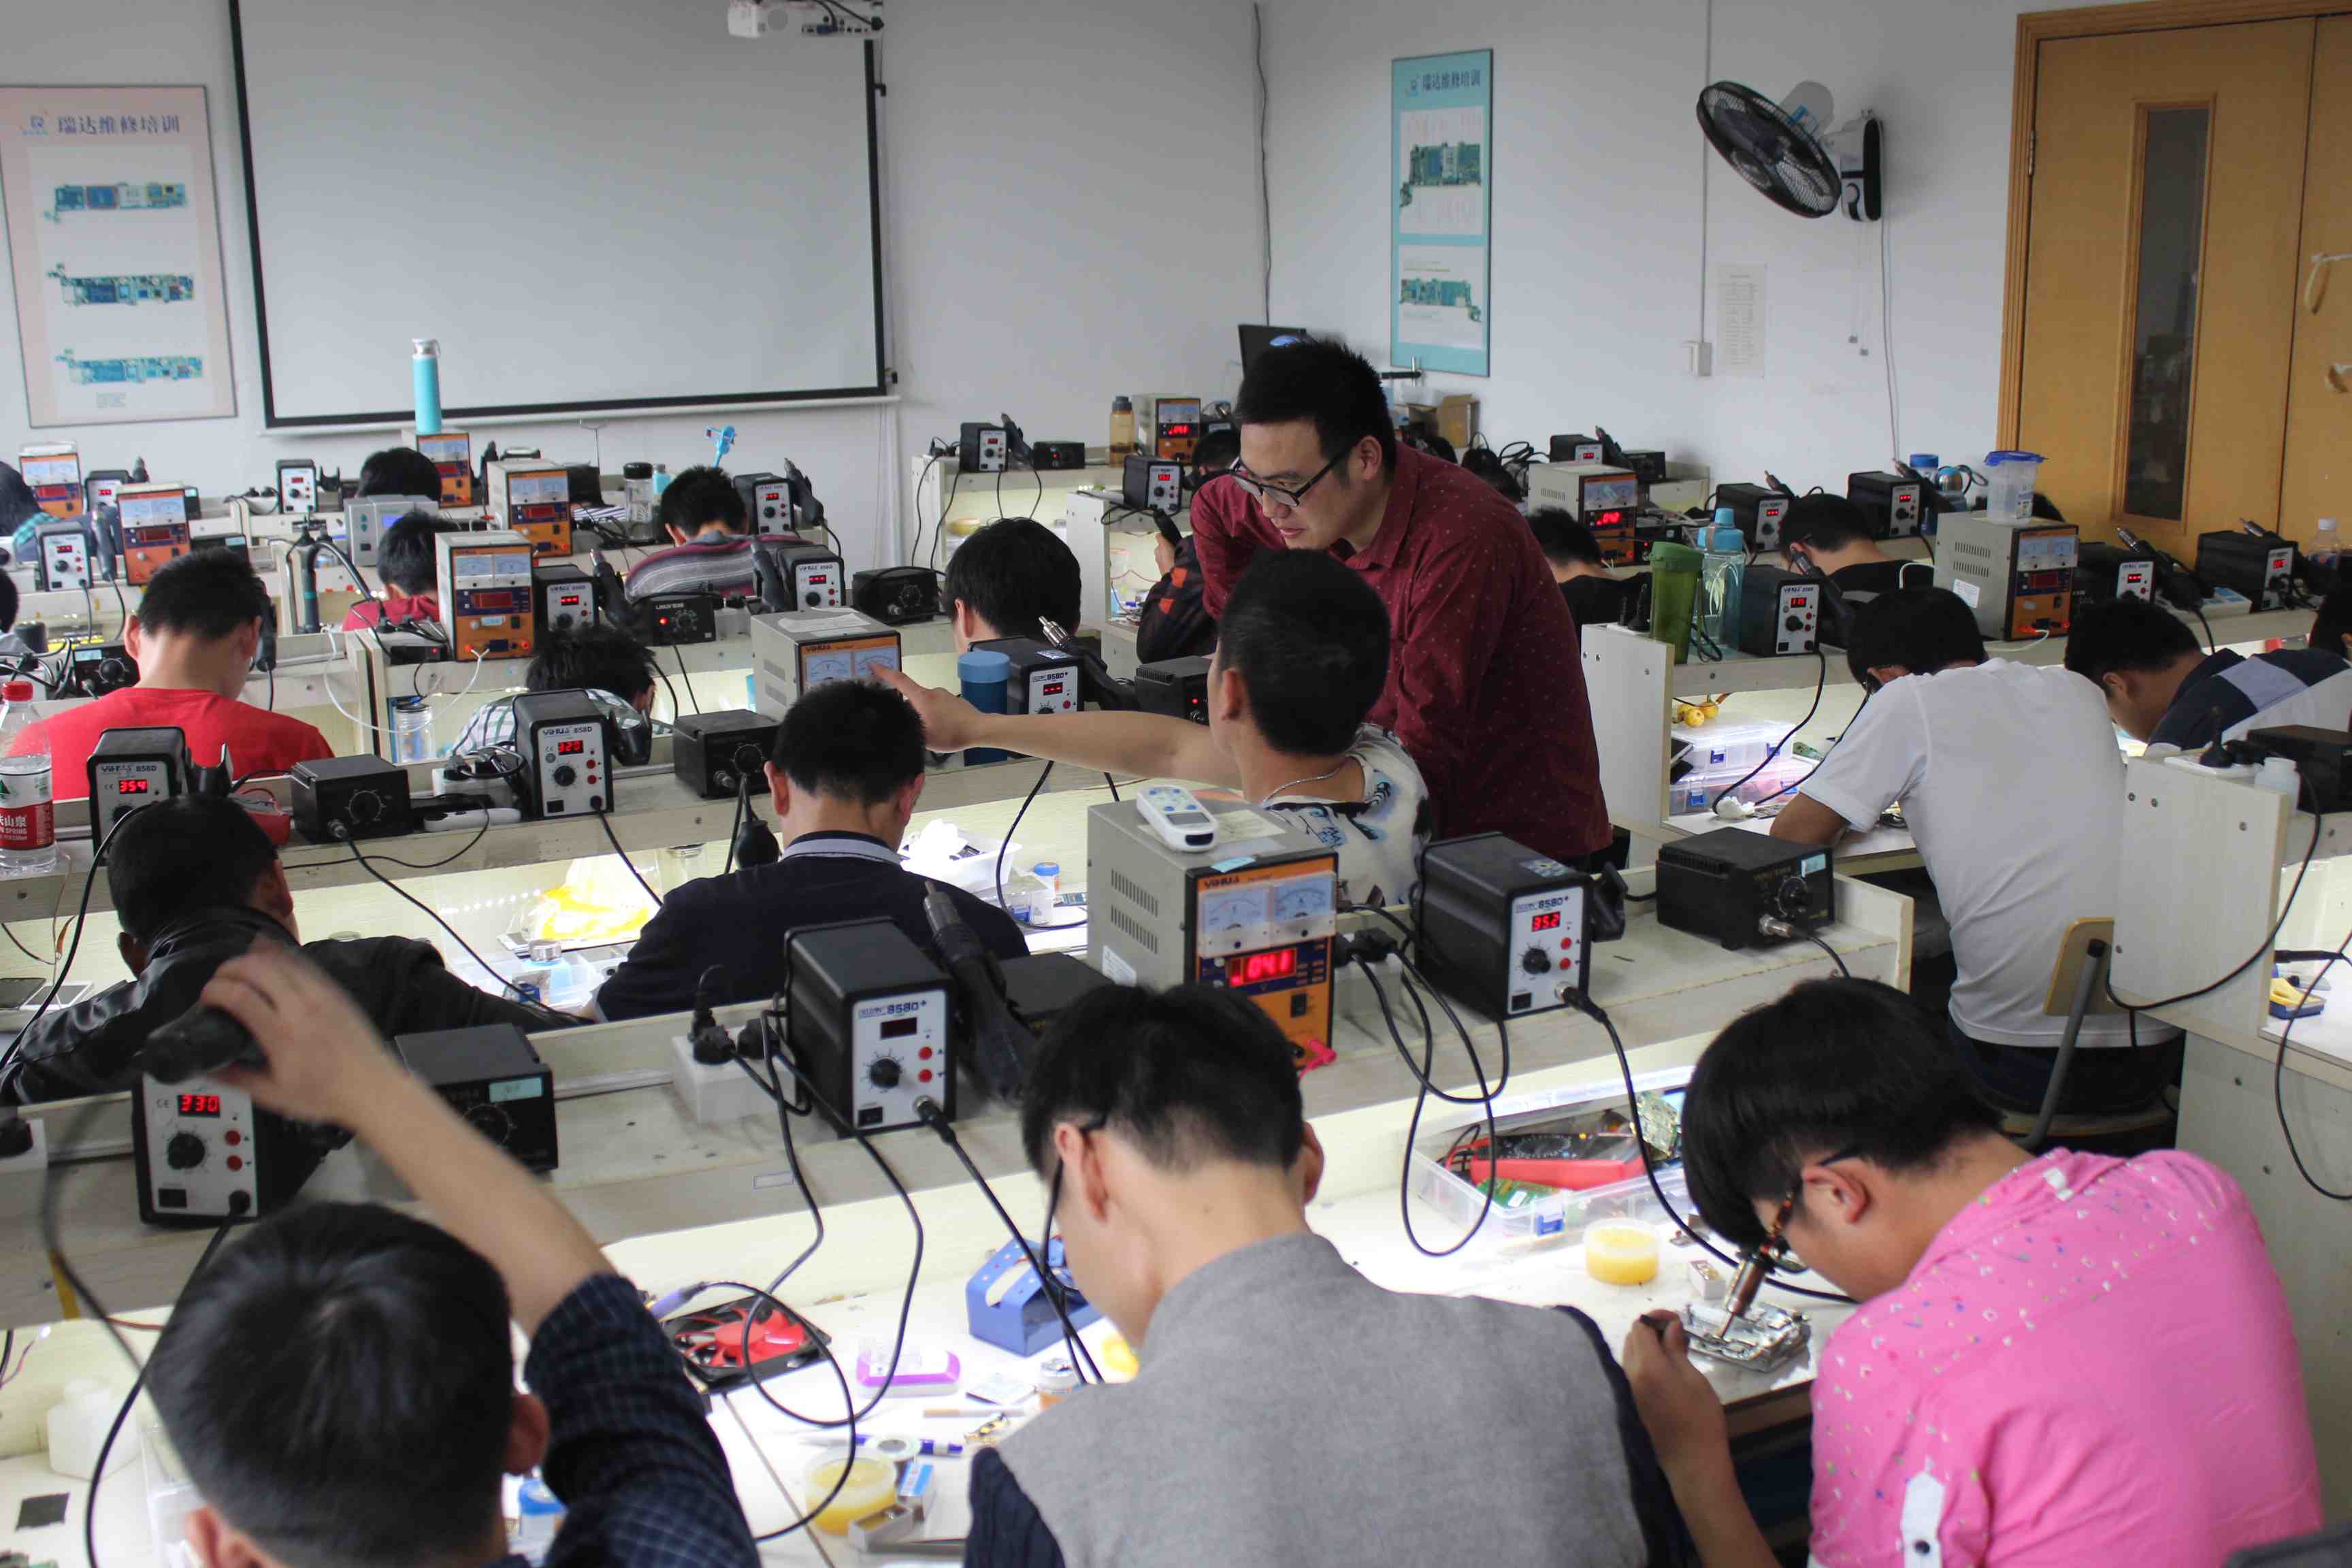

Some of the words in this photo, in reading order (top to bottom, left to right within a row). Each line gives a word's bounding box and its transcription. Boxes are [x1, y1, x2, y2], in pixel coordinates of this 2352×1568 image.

[57, 114, 180, 135] 瑞达维修培训
[1532, 912, 1559, 930] 352
[180, 1094, 219, 1111] 330
